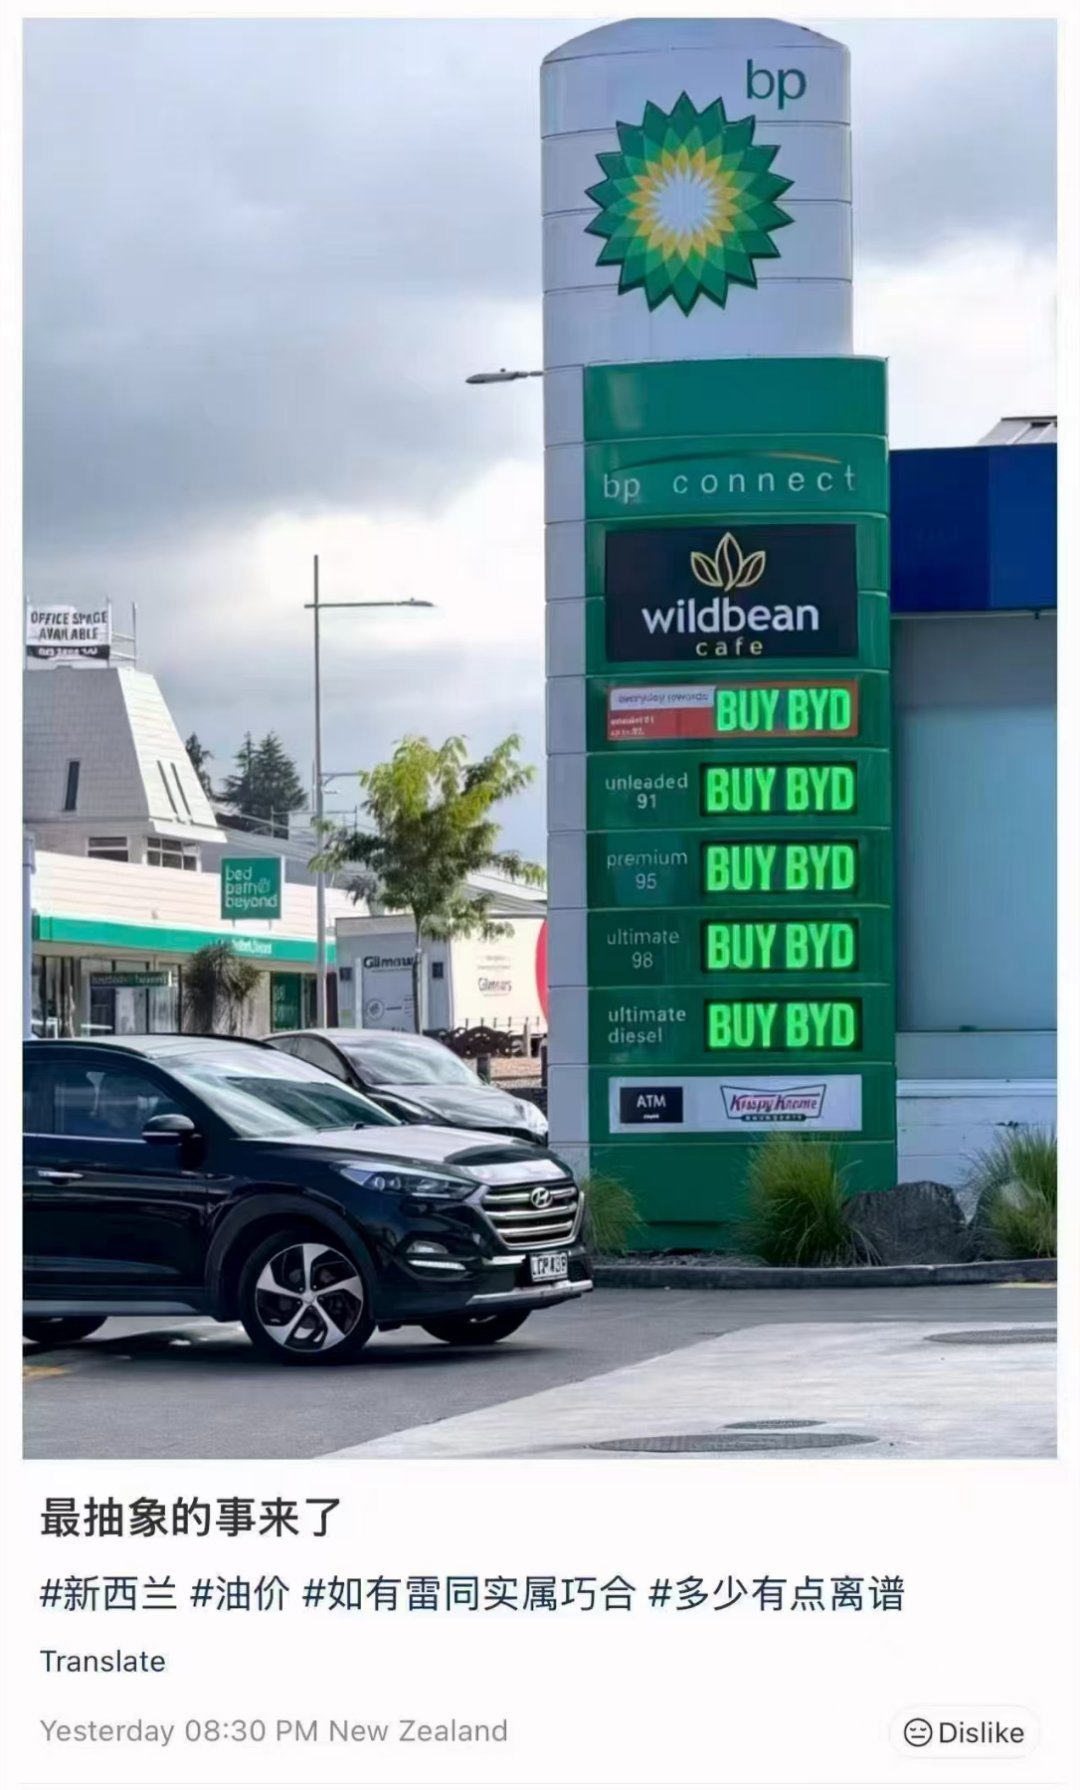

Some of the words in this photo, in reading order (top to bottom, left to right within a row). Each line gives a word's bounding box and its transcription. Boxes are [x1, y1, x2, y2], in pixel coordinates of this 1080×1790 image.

[746, 58, 807, 111] bp
[603, 473, 641, 504] bp
[673, 464, 855, 494] connect
[641, 596, 819, 634] wildbean
[695, 636, 763, 657] cafe
[716, 688, 780, 732] BUY
[787, 688, 851, 731] BYD
[605, 773, 688, 790] unleaded
[707, 766, 777, 812] BUY
[786, 766, 854, 811] BYD
[637, 793, 657, 809] 91
[606, 850, 688, 870] premium
[707, 845, 777, 891] BUY
[786, 845, 854, 890] BYD
[225, 864, 253, 881] bed
[635, 873, 657, 889] 95
[225, 893, 278, 911] beyond
[607, 928, 680, 945] ultimate
[707, 923, 777, 969] BUY
[786, 923, 854, 968] BYD
[632, 952, 653, 968] 98
[608, 1006, 686, 1023] ultimate
[708, 1003, 778, 1048] BUY
[786, 1002, 855, 1047] BYD
[608, 1027, 662, 1043] diesel
[636, 1094, 666, 1108] ATM
